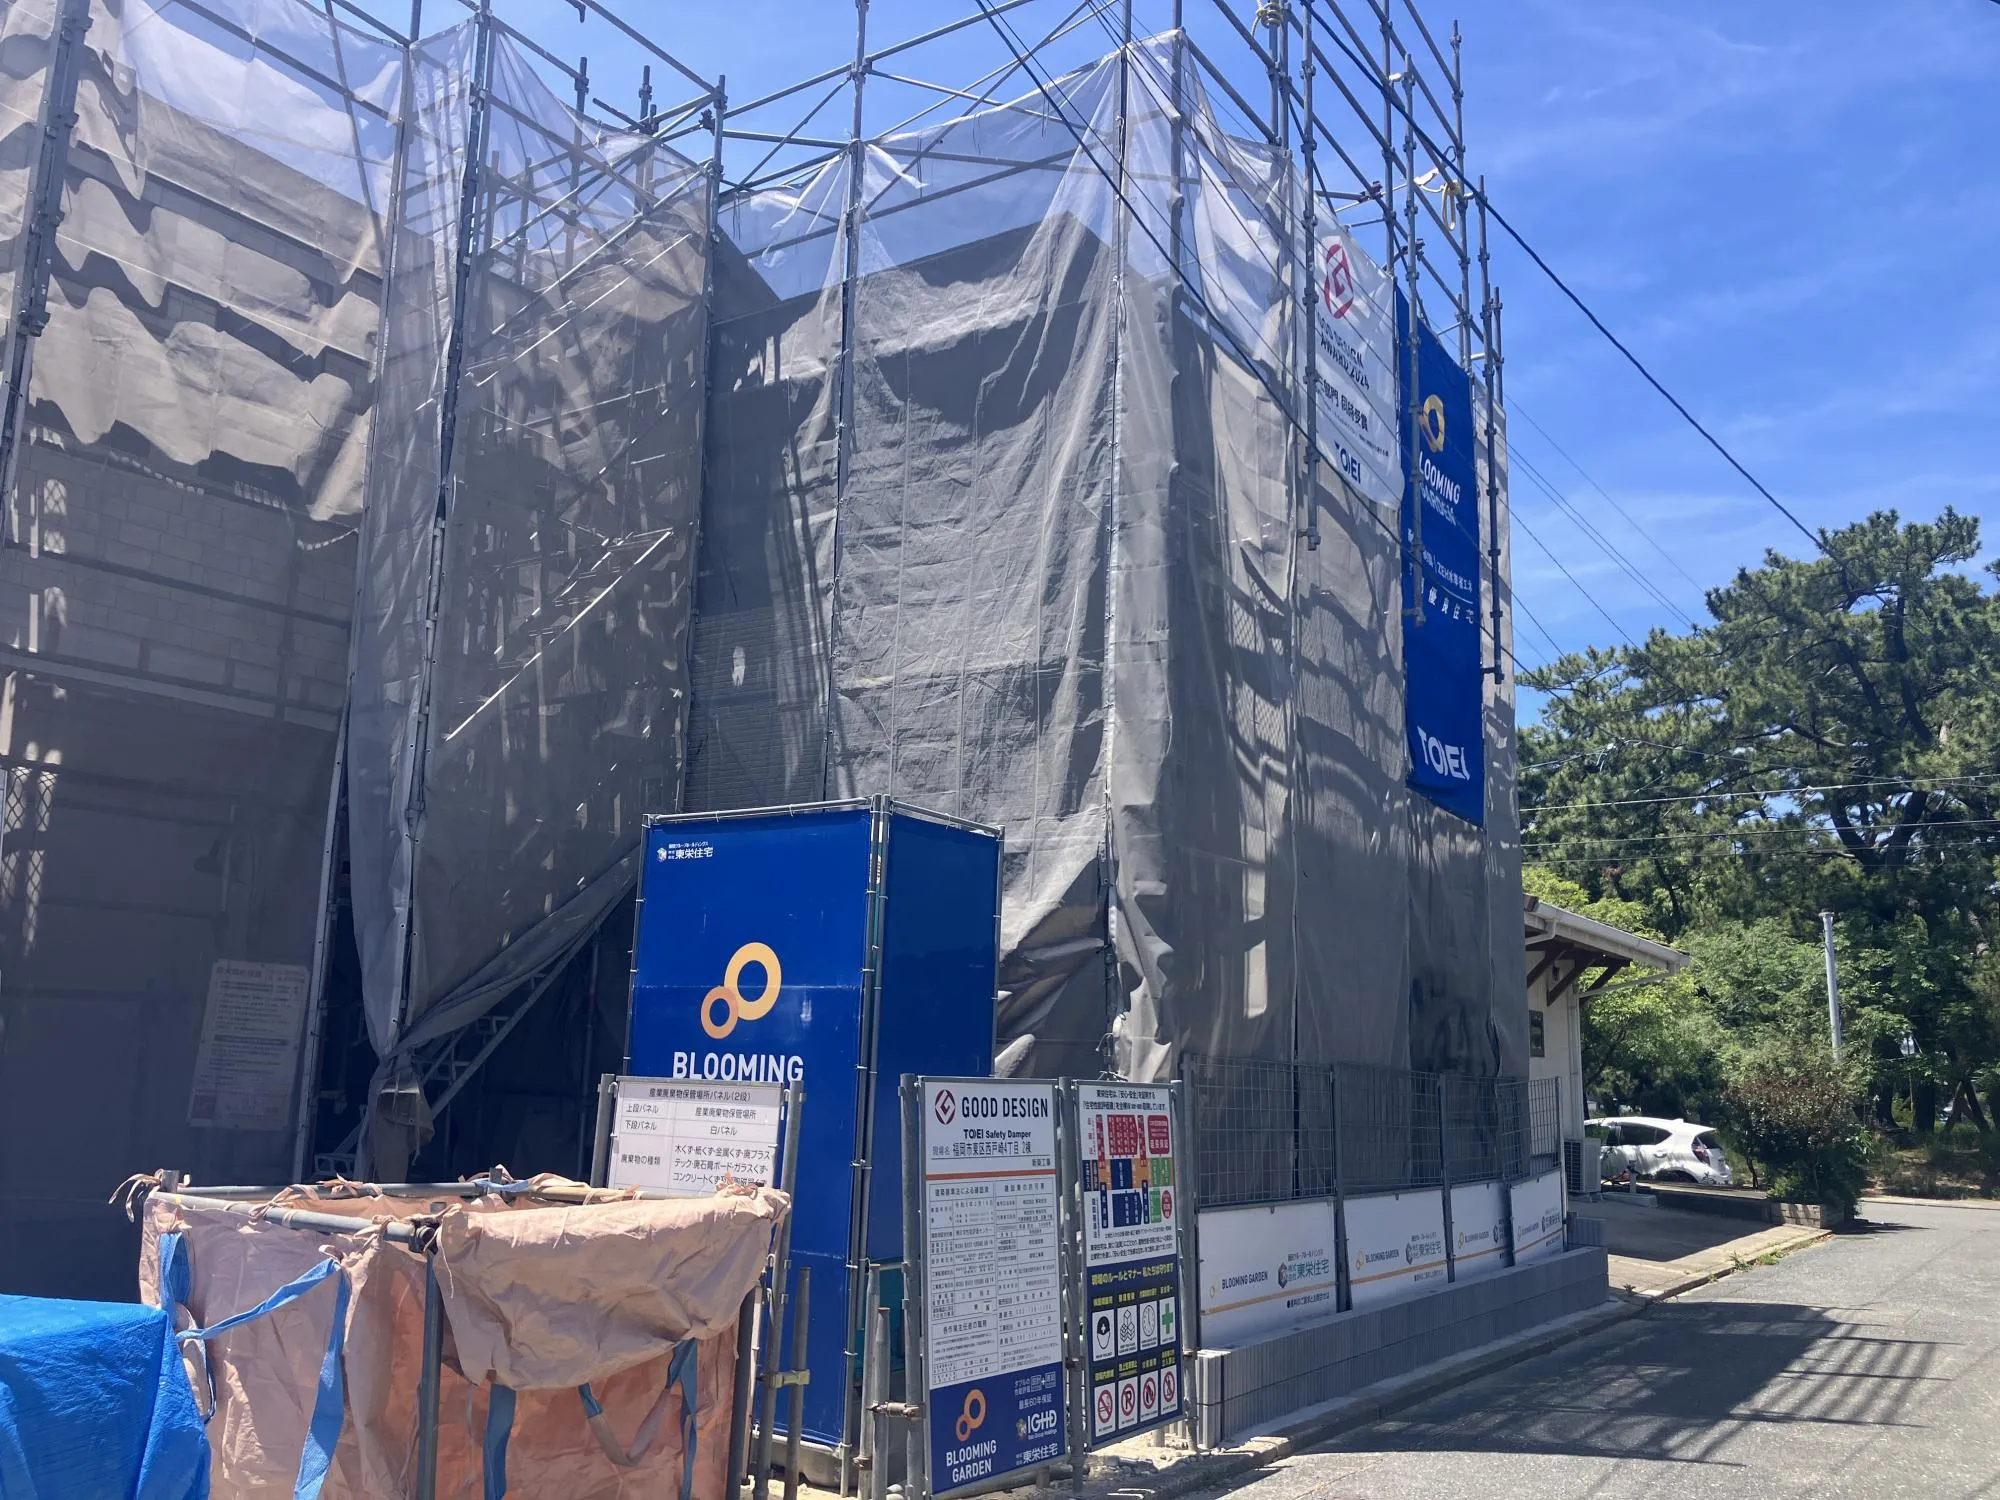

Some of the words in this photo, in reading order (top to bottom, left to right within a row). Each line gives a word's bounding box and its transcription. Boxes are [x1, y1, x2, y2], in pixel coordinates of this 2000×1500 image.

[1418, 450, 1461, 505] LOOMING
[675, 847, 713, 860] 東栄住宅
[672, 1051, 804, 1083] BLOOMING
[626, 1103, 658, 1114] 上段パネル
[962, 1097, 998, 1118] GOOD
[1003, 1097, 1048, 1118] DESIGN
[625, 1120, 657, 1130] 下段パネル
[710, 1125, 737, 1136] 白パネル
[986, 1129, 1006, 1140] Safety
[1007, 1129, 1031, 1140] Damper
[621, 1154, 660, 1166] 廃棄物の種類
[1296, 1259, 1330, 1279] 東栄住宅
[1221, 1274, 1248, 1290] BLOOMING
[1248, 1270, 1269, 1286] GARDEN
[946, 1440, 997, 1467] BLOOMING
[1023, 1443, 1058, 1464] 東栄住宅
[952, 1459, 992, 1483] GARDEN
